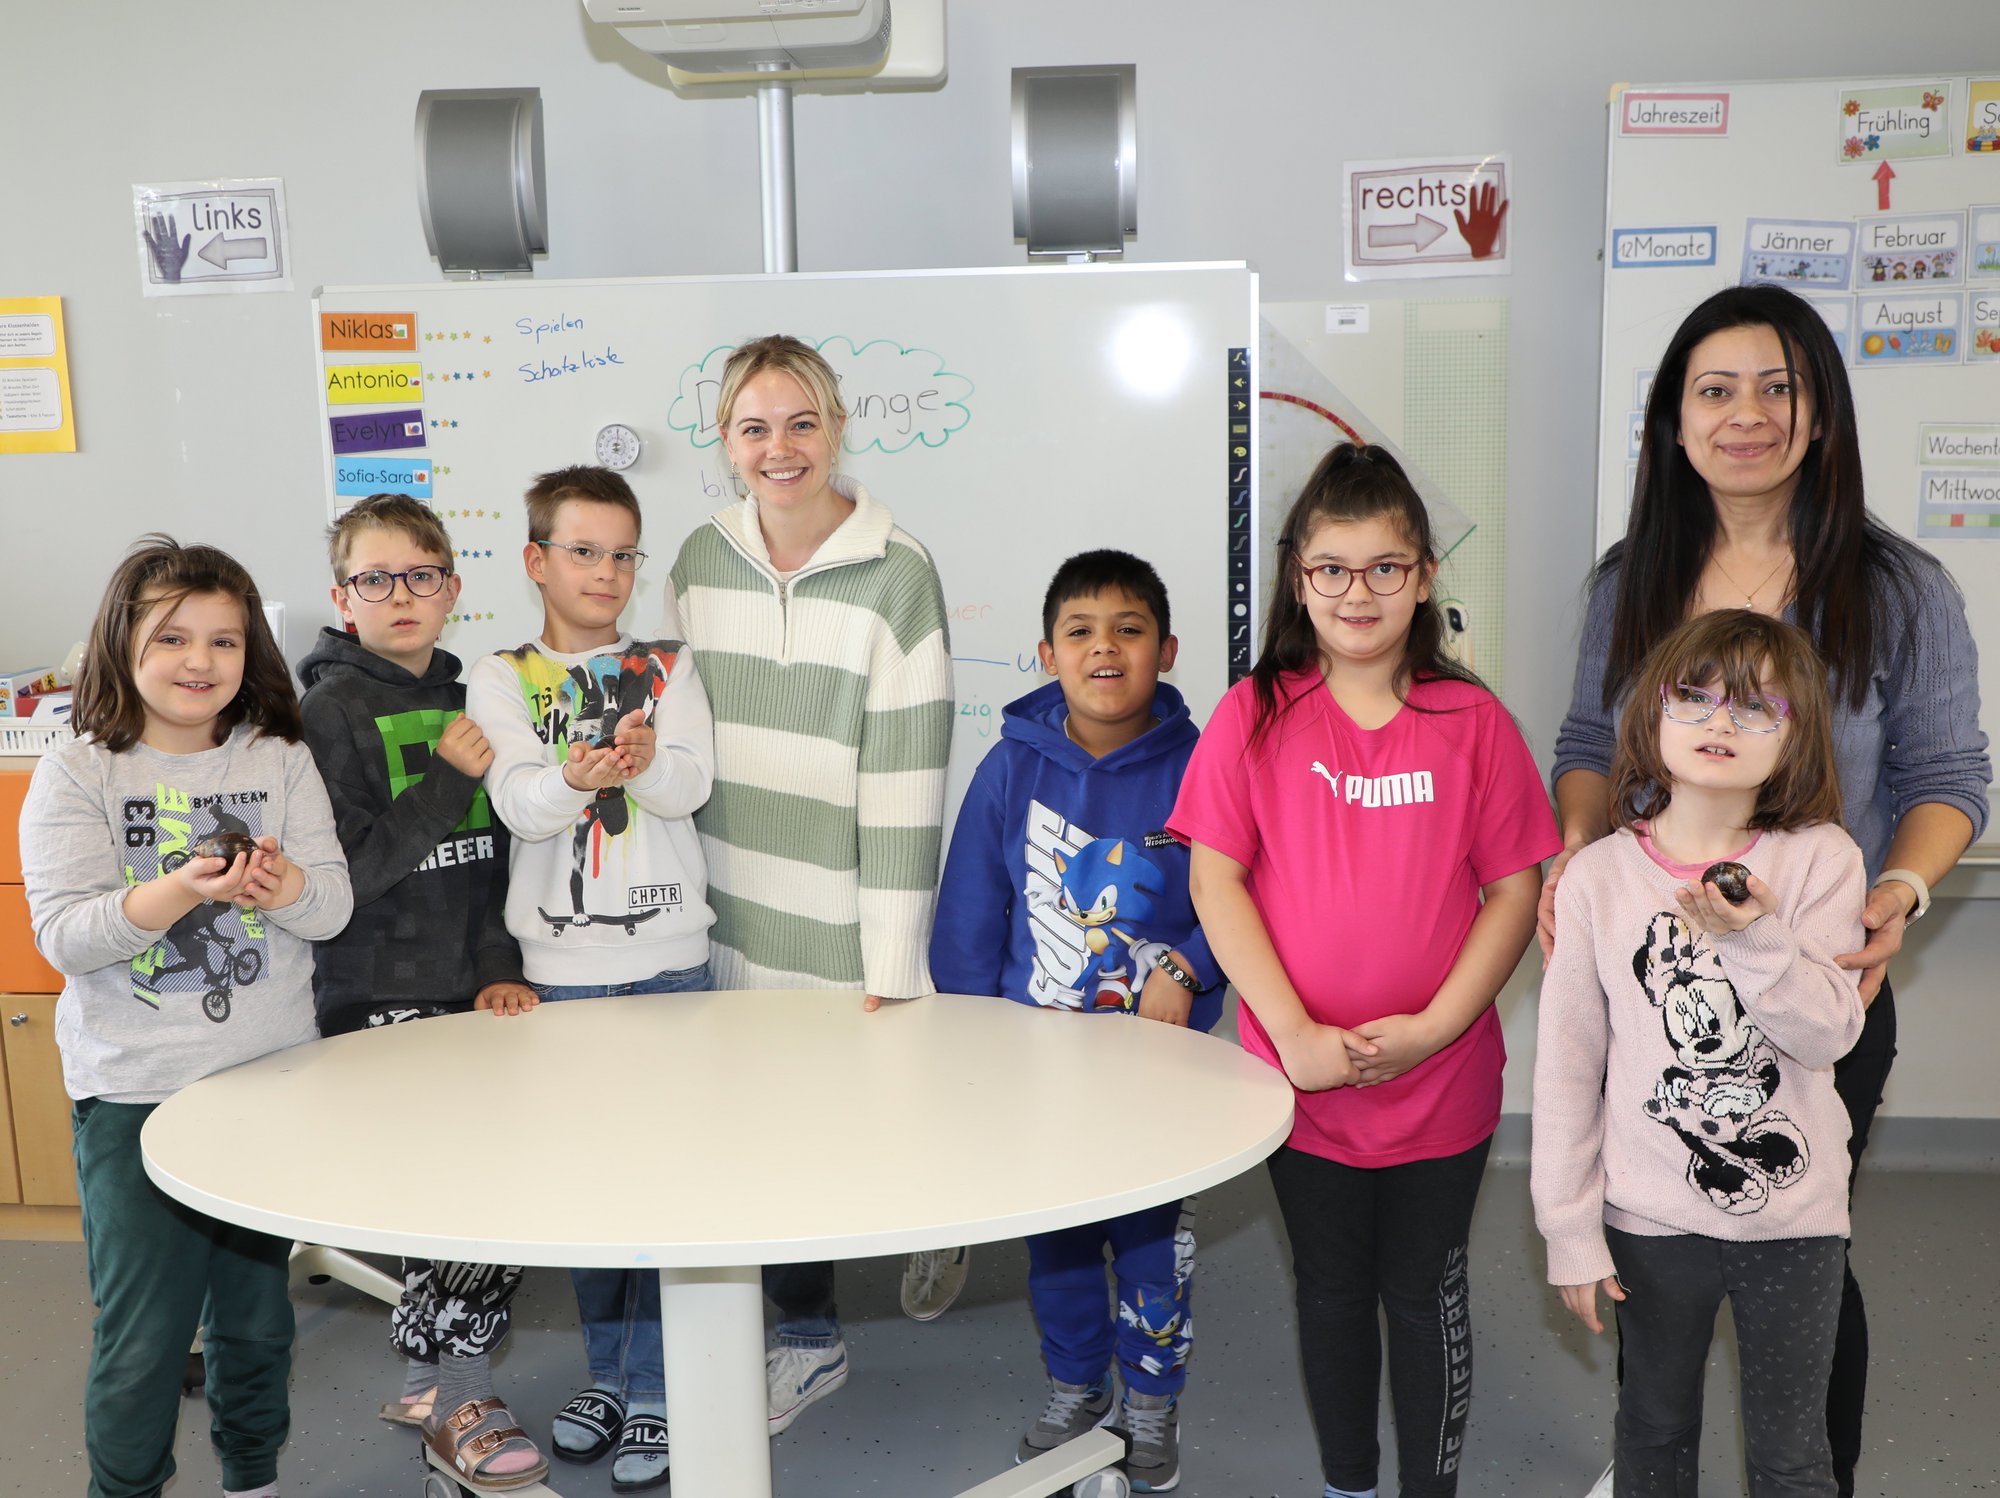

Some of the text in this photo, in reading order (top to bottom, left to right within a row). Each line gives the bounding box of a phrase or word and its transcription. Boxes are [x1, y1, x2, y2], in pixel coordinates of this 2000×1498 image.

[1629, 101, 1721, 125] Jahreszeit
[1857, 109, 1930, 138] Frühling
[1361, 178, 1467, 211] rechts
[192, 202, 262, 231] links
[1761, 231, 1835, 252] Jänner
[1873, 224, 1947, 248] Februar
[330, 319, 394, 340] Niklas
[515, 312, 584, 345] Spielen
[1875, 300, 1944, 335] August
[328, 369, 408, 391] Antonio
[335, 420, 405, 445] Evelyn
[1928, 436, 2000, 456] Wochent
[338, 469, 413, 484] Sofia-Sara
[947, 604, 993, 621] uer
[955, 694, 992, 738] zig
[193, 791, 268, 809] BMX TEAM
[1345, 770, 1435, 808] PUMA
[631, 887, 678, 905] CHPTR
[564, 1399, 606, 1420] FILA
[620, 1426, 668, 1446] FILA
[1443, 1434, 1462, 1475] BE
